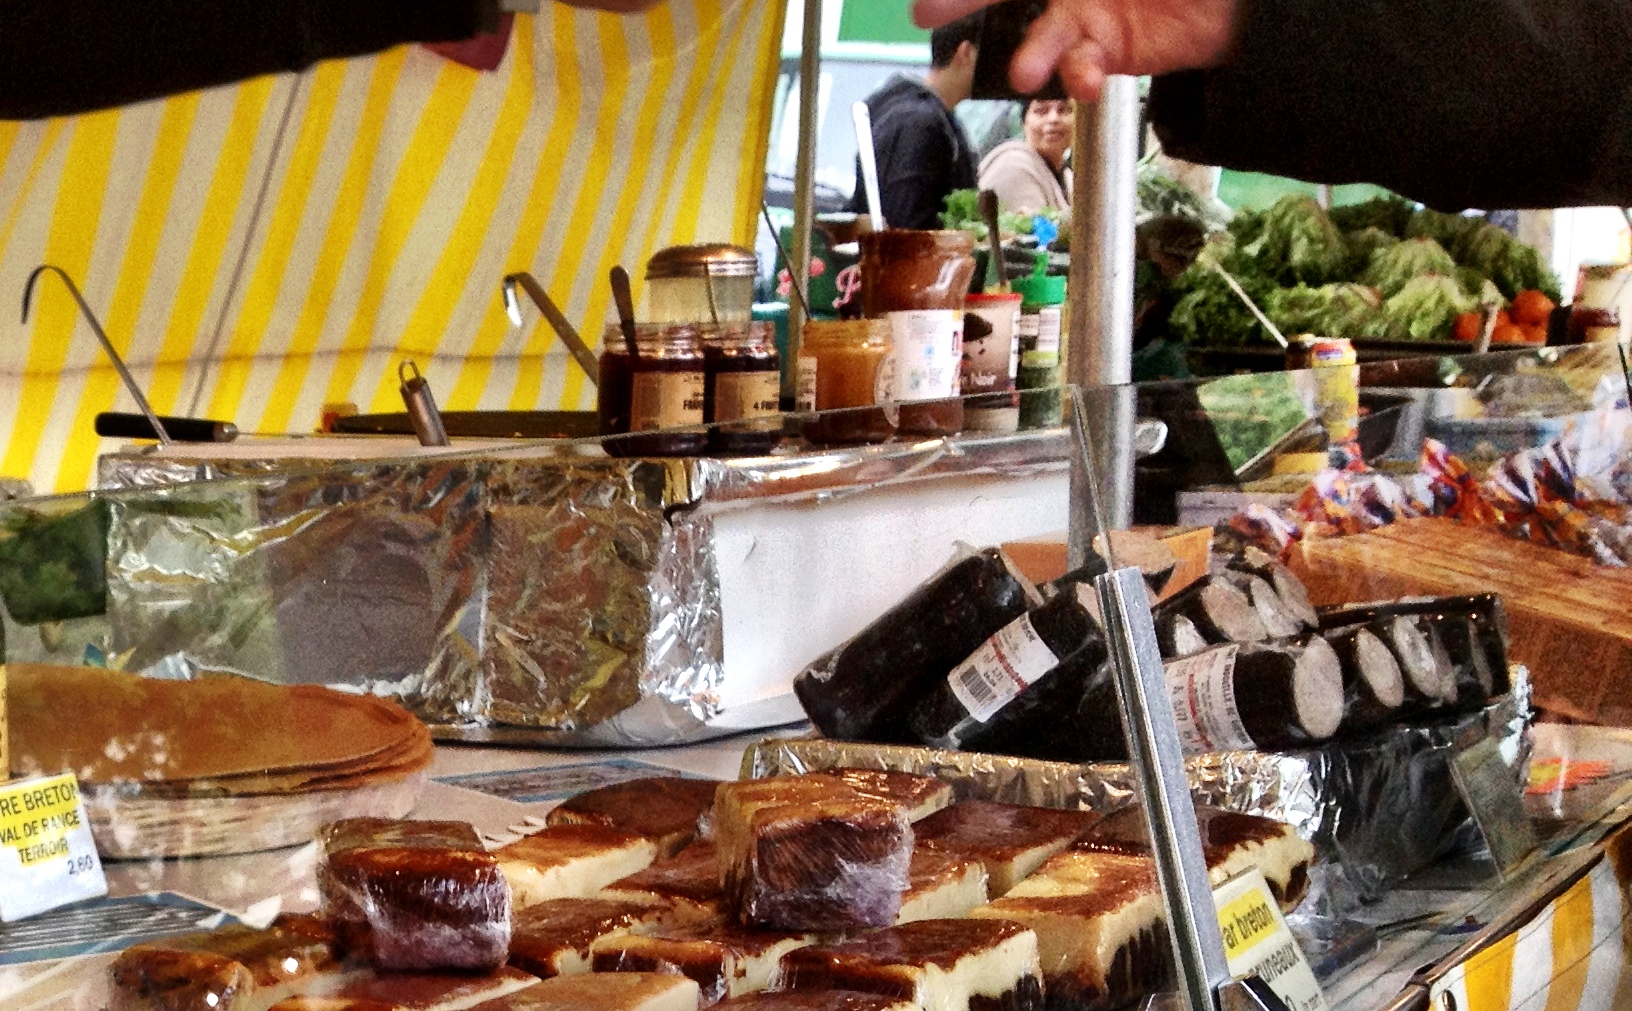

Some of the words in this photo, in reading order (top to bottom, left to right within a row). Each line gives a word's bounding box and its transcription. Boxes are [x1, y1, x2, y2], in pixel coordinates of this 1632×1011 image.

[24, 820, 38, 837] DE
[1223, 924, 1240, 950] ar
[1234, 901, 1276, 941] breton
